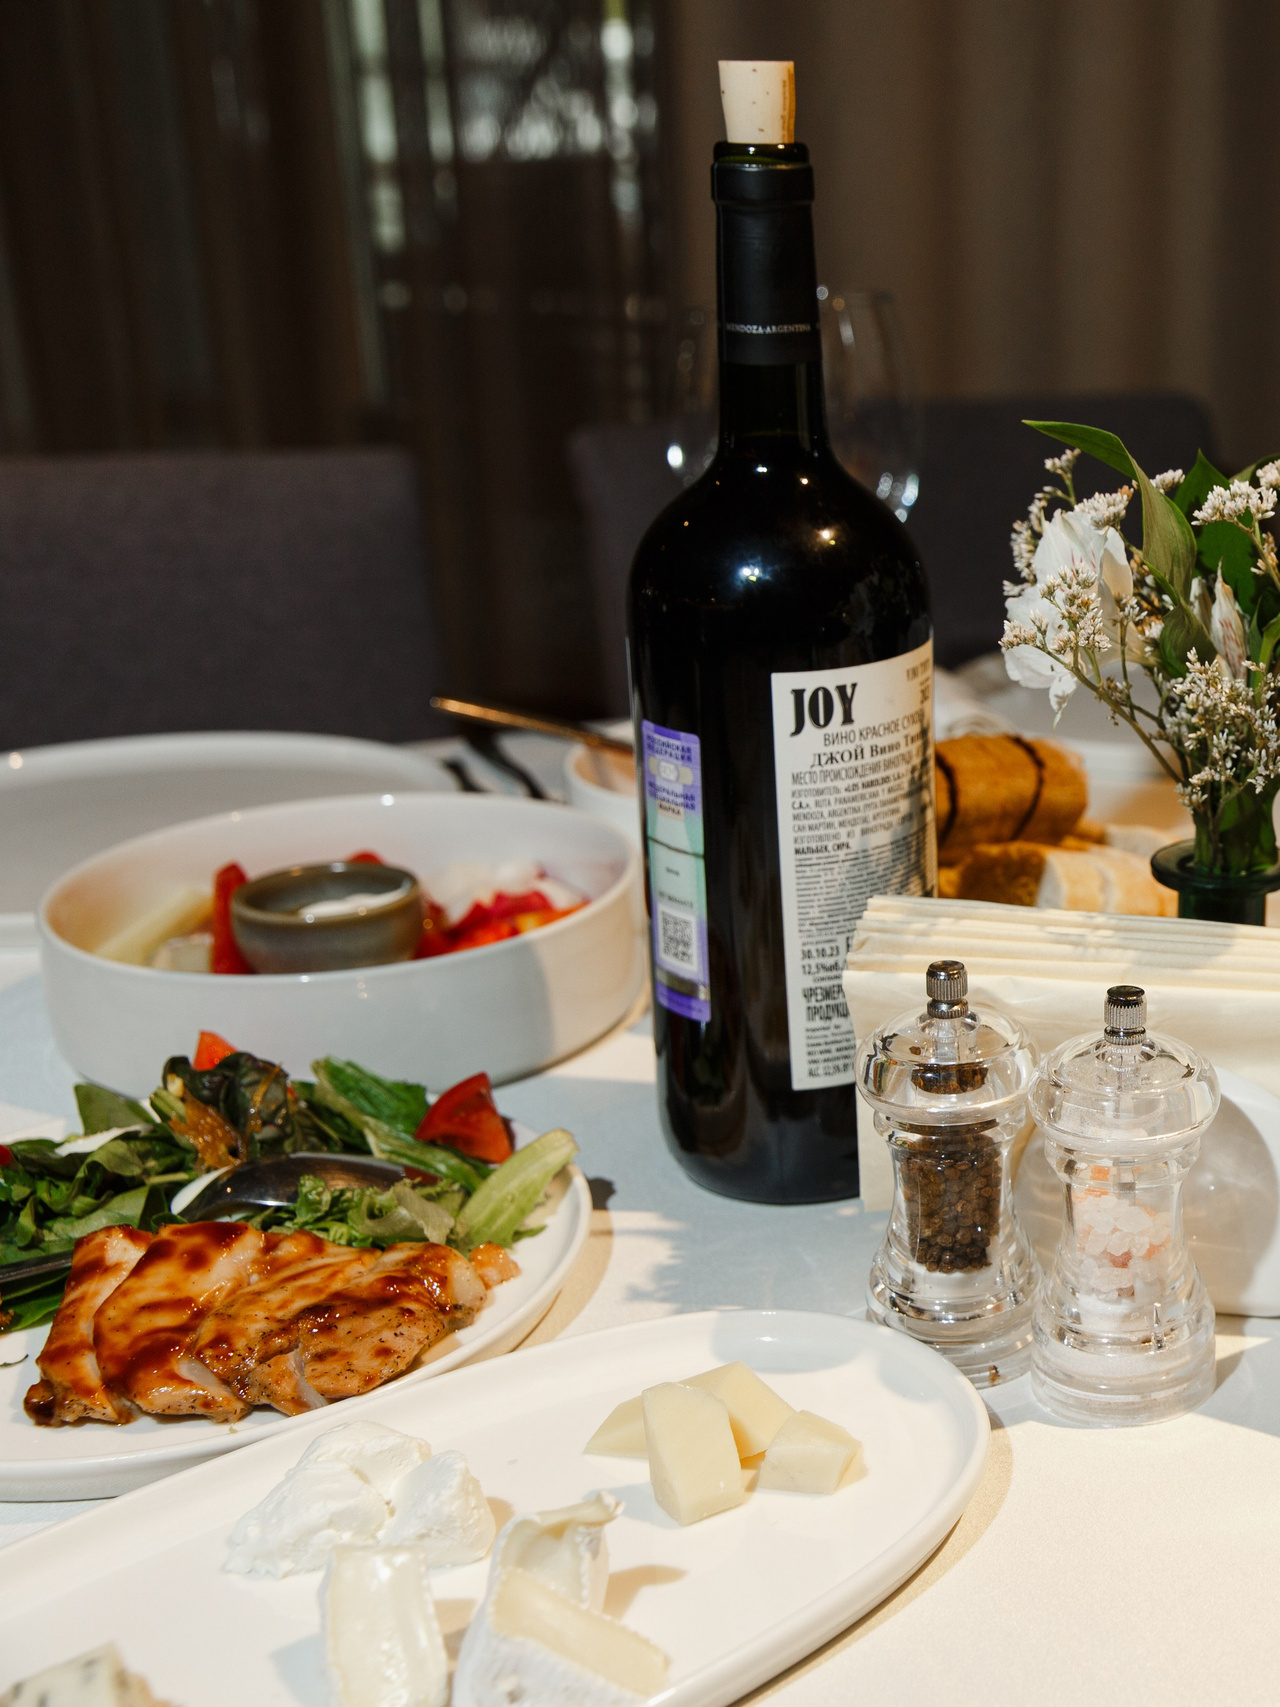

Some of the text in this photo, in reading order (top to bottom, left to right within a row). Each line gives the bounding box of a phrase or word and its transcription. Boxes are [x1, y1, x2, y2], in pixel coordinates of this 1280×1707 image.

[790, 683, 857, 737] JOY
[824, 730, 856, 747] ВИНО
[859, 719, 900, 742] КРАСНОЕ
[810, 744, 865, 769] ДЖОЙ
[792, 771, 817, 786] МЕСТО
[802, 984, 845, 1003] ЧРЕЗМЕР
[806, 1001, 850, 1022] ПРОДУКЦ
